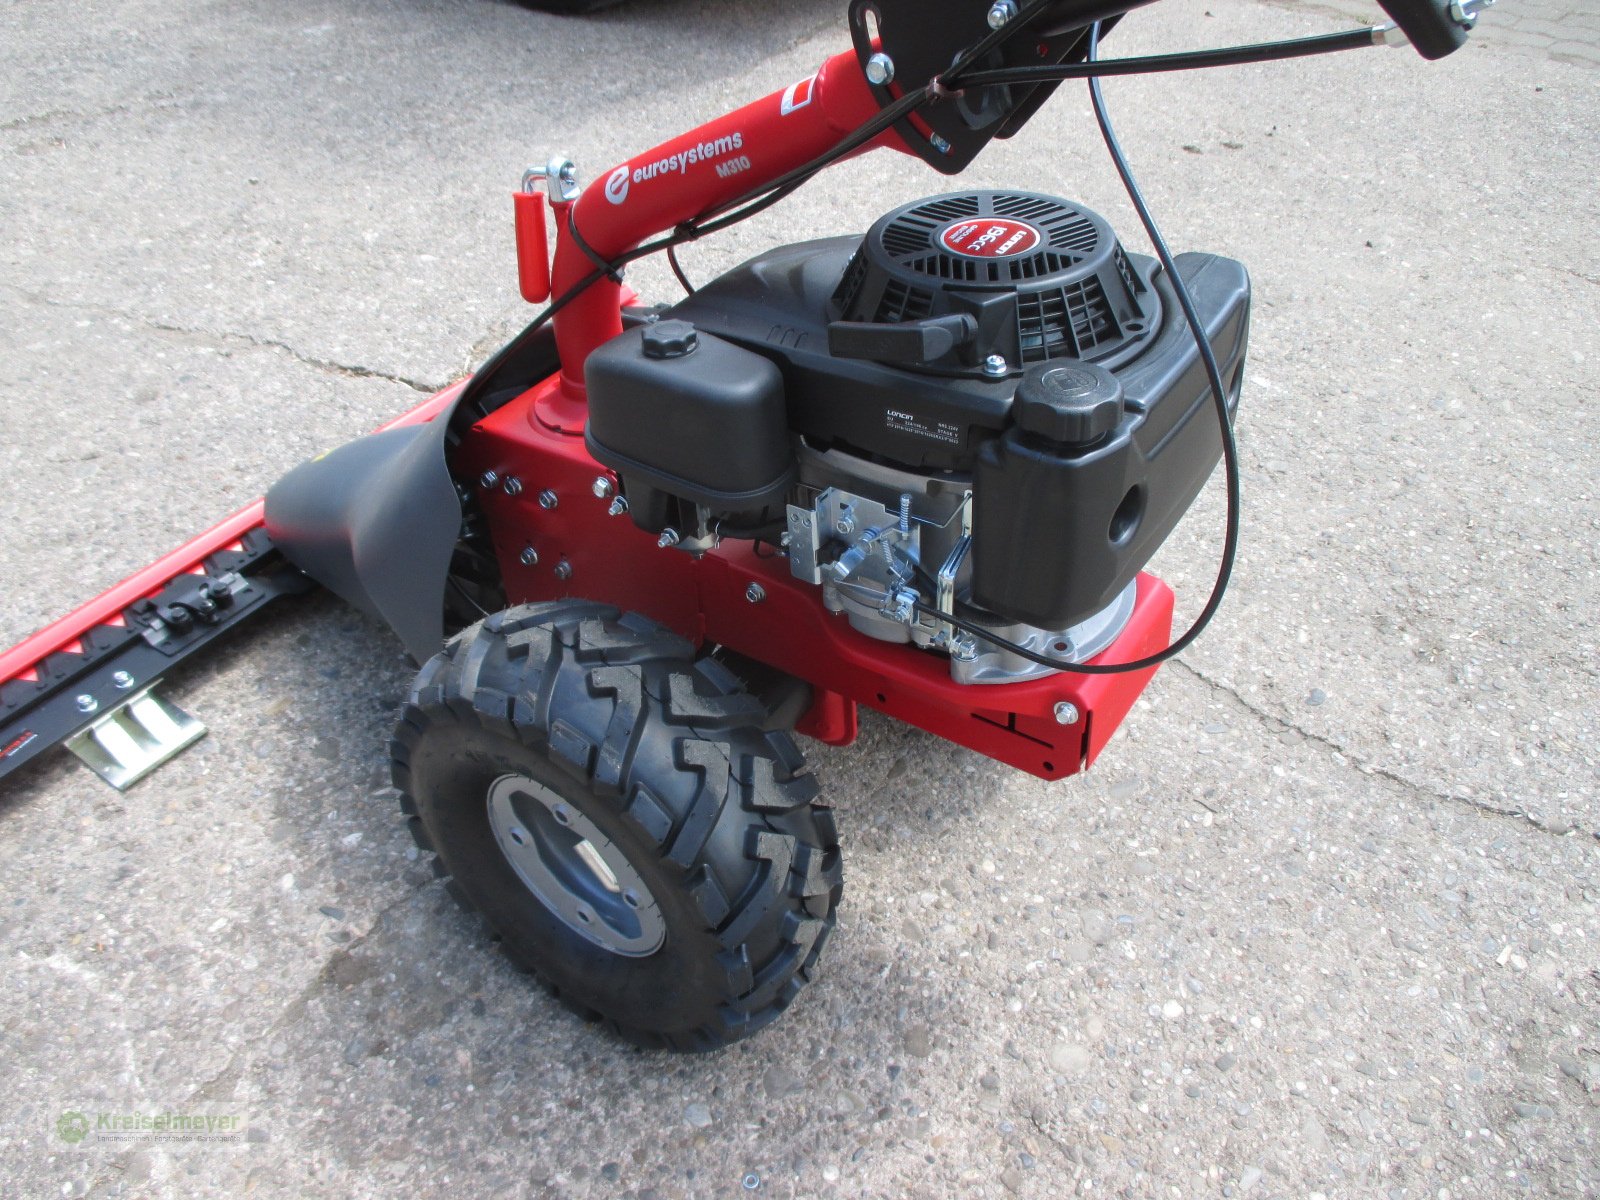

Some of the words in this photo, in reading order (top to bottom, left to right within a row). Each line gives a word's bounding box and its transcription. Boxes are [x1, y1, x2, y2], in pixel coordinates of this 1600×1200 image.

[632, 132, 743, 183] eurosystems
[715, 155, 751, 178] M310
[966, 225, 1008, 251] 196cc
